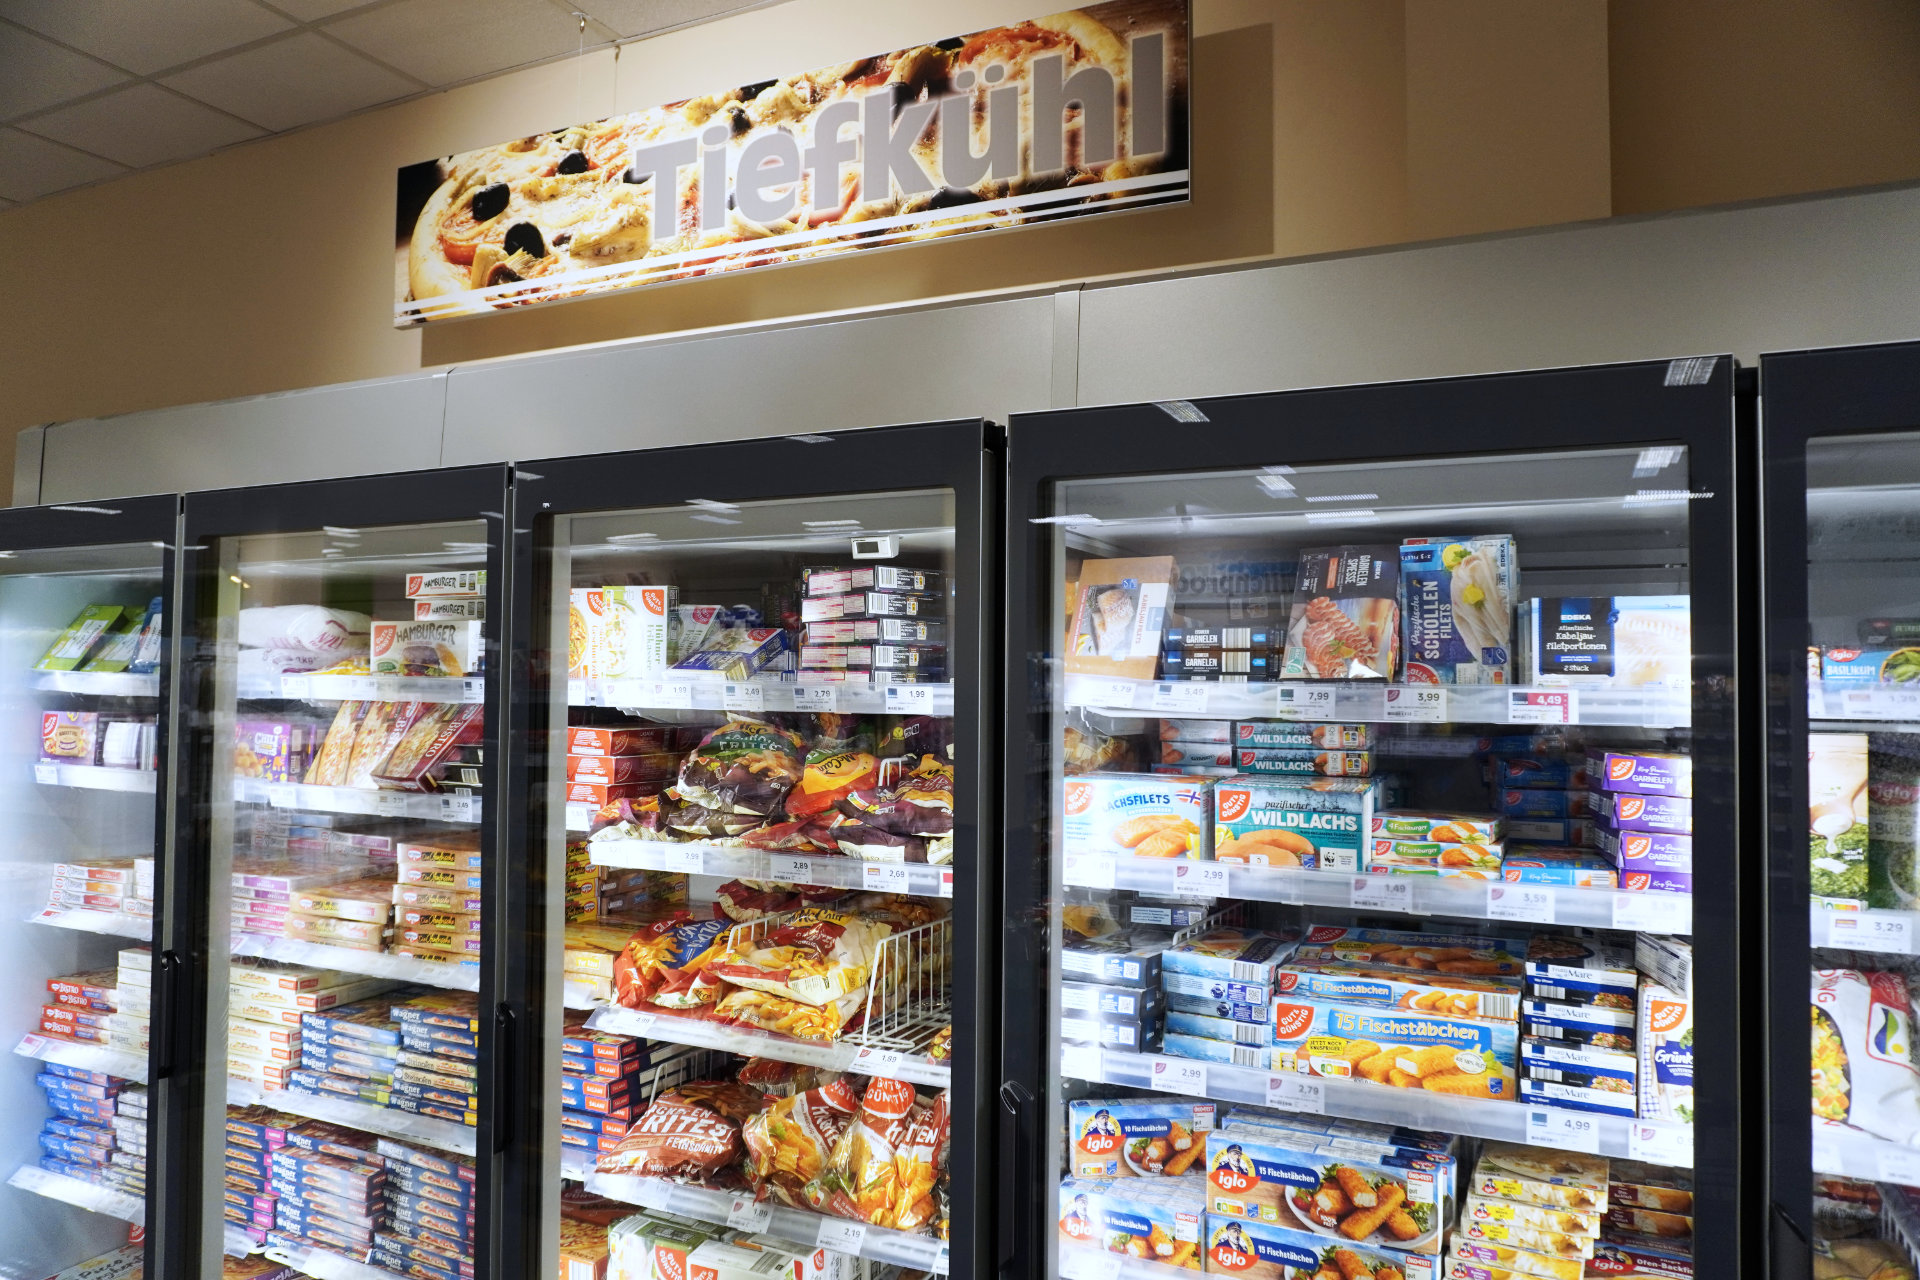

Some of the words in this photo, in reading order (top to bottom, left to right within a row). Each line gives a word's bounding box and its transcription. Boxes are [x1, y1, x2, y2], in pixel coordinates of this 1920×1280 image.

[634, 33, 1167, 241] Tiefkühl
[424, 577, 456, 589] HAMBURGER
[431, 604, 465, 617] HAMBURGER
[1423, 581, 1440, 660] SCHOLLEN
[1441, 604, 1452, 639] FILETS
[396, 623, 456, 645] HAMBURGER
[1186, 635, 1218, 644] GARNELEN
[1556, 632, 1597, 642] Kabeljau-
[1546, 642, 1607, 651] filetportionen
[1833, 651, 1853, 659] iglo
[1185, 658, 1218, 667] GARNELEN
[1826, 665, 1875, 676] BASILIKUM
[673, 686, 687, 695] 1,99
[745, 688, 760, 697] 2,49
[814, 690, 831, 698] 2,79
[909, 690, 925, 698] 1,99
[1112, 684, 1132, 694] 5,79
[1184, 688, 1204, 697] 5,49
[1308, 691, 1329, 701] 7,99
[1417, 692, 1440, 702] 3,99
[1537, 695, 1562, 705] 4,49
[254, 733, 278, 745] CHILI
[1254, 734, 1312, 745] WILDLACHS
[817, 754, 855, 774] McCain
[1255, 761, 1315, 771] WILDLACHS
[1632, 775, 1673, 784] GARNELEN
[1104, 794, 1171, 812] ACHSFILETS
[1221, 794, 1246, 818] GÜNSTIG
[1222, 795, 1239, 811] GUT&
[1251, 811, 1358, 831] WILDLACHS
[1641, 814, 1683, 823] GARNELEN
[685, 852, 699, 861] 2,99
[1402, 846, 1438, 855] Fischburger
[1648, 853, 1689, 862] GARNELEN
[793, 861, 809, 870] 2,89
[889, 869, 905, 878] 2,69
[1204, 870, 1223, 879] 2,99
[1385, 884, 1406, 893] 1,49
[1523, 893, 1547, 904] 3,59
[1874, 922, 1903, 933] 3,29
[1366, 930, 1385, 940] 15
[1389, 930, 1494, 946] Fischstäbchen
[1568, 969, 1592, 980] Mare
[1312, 980, 1323, 991] 15
[1324, 982, 1390, 996] Fischstäbchen
[392, 1008, 420, 1021] Wagner
[1281, 1008, 1301, 1026] GUT&
[1567, 1008, 1591, 1019] Mare
[302, 1014, 327, 1026] Wagner
[1279, 1008, 1309, 1035] GÜNSTIG
[402, 1023, 429, 1037] Wagner
[1335, 1012, 1355, 1031] 15
[1358, 1016, 1480, 1041] Fischstäbchen
[302, 1029, 328, 1041] Wagner
[302, 1043, 328, 1055] Wagner
[404, 1038, 431, 1050] Wagner
[597, 1048, 615, 1056] SALAMI
[1566, 1051, 1591, 1063] Mare
[1655, 1050, 1693, 1063] Grünk
[302, 1057, 328, 1070] Wagner
[406, 1058, 434, 1070] Steinofen
[599, 1066, 616, 1074] SALAMI
[1181, 1068, 1202, 1079] 2,99
[291, 1071, 317, 1084] Wagner
[404, 1073, 432, 1085] Steinofen
[393, 1082, 420, 1095] Wagner
[586, 1085, 603, 1094] SALAMI
[1298, 1084, 1319, 1096] 2,79
[1565, 1088, 1590, 1099] Mare
[391, 1096, 417, 1109] Wagner
[588, 1101, 606, 1110] SALAMI
[606, 1125, 623, 1134] SALAMI
[1125, 1124, 1131, 1132] 10
[1132, 1124, 1168, 1133] Fischstäbchen
[1564, 1120, 1591, 1131] 4,99
[287, 1133, 312, 1146] Wagner
[1086, 1137, 1114, 1152] iglo
[378, 1139, 404, 1154] Wagner
[272, 1152, 297, 1165] Wagner
[272, 1165, 297, 1178] Wagner
[385, 1158, 412, 1173] Wagner
[387, 1174, 412, 1188] Wagner
[1218, 1171, 1247, 1189] iglo
[1259, 1166, 1266, 1175] 15
[1267, 1167, 1315, 1184] Fischstäbchen
[1407, 1172, 1433, 1182] ÖKO-TEST
[271, 1179, 297, 1193] Wagner
[1408, 1188, 1418, 1196] gut
[384, 1189, 410, 1203] Wagner
[277, 1203, 302, 1217] Wagner
[387, 1203, 413, 1217] Wagner
[753, 1208, 768, 1218] 1,89
[277, 1217, 302, 1231] Wagner
[385, 1217, 411, 1232] Wagner
[1111, 1219, 1149, 1231] Fischstäbchen
[1320, 1214, 1338, 1225] 100%
[844, 1228, 860, 1238] 2,19
[1065, 1219, 1093, 1236] iglo
[375, 1235, 401, 1250] Wagner
[375, 1251, 401, 1266] Wagner
[1218, 1249, 1246, 1267] iglo
[1258, 1244, 1265, 1254] 15
[1266, 1246, 1314, 1265] Fischstäbchen
[1405, 1257, 1431, 1268] ÖKO-TEST
[1594, 1260, 1624, 1271] iglo
